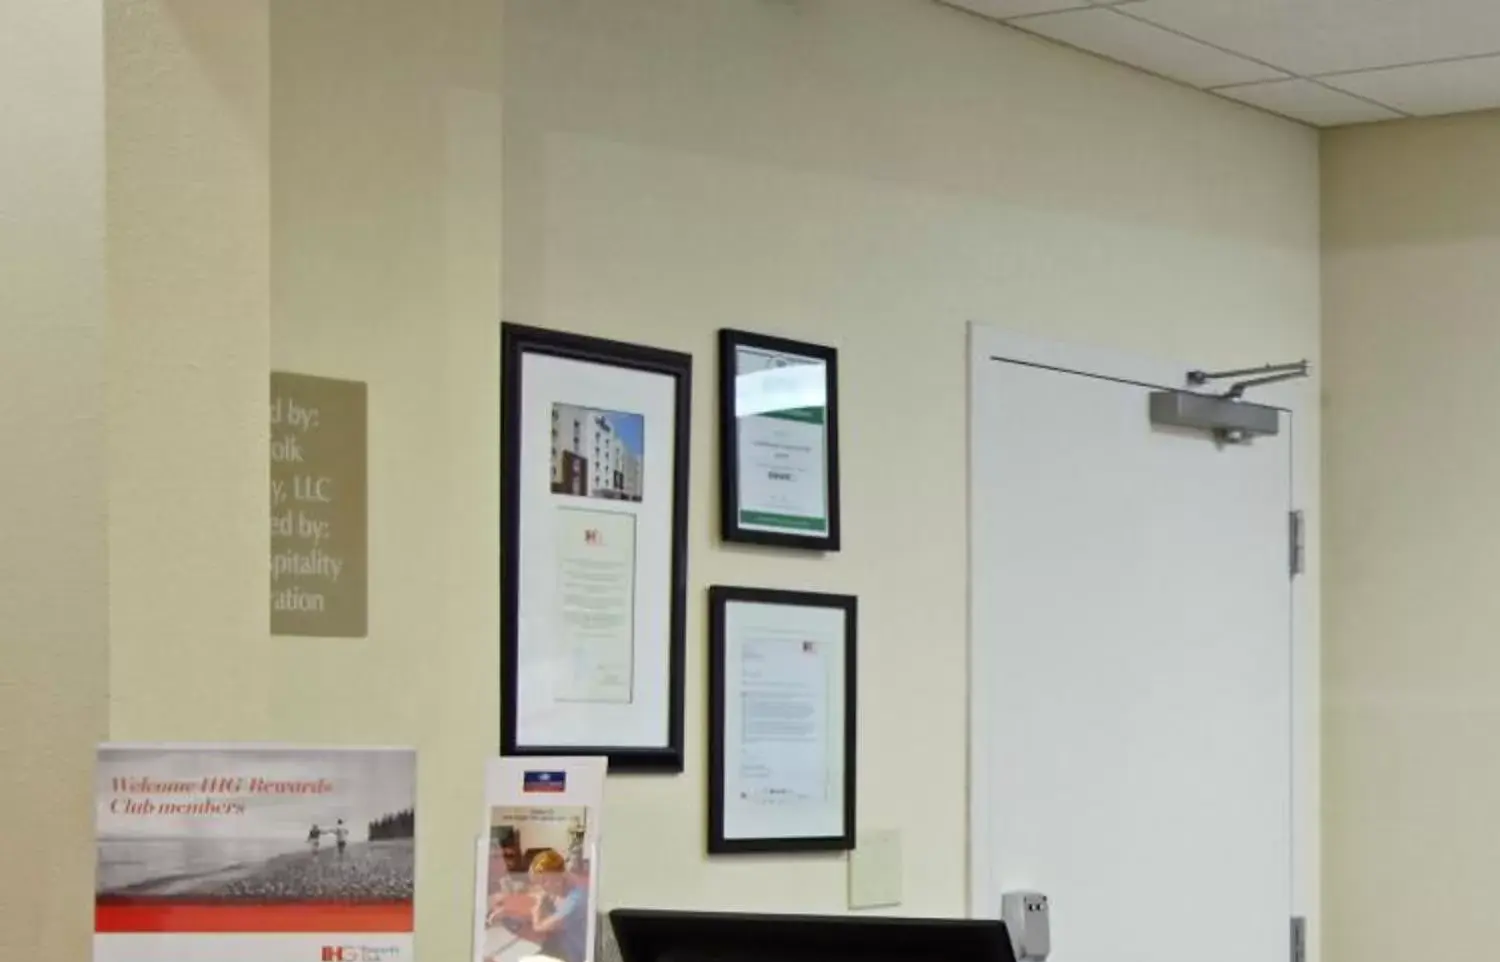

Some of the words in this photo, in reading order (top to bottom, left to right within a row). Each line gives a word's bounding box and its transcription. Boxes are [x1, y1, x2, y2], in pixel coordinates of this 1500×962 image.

[287, 397, 320, 433] by:
[293, 475, 333, 503] LLC
[299, 511, 329, 547] by:
[111, 776, 195, 794] Welcome
[200, 776, 244, 794] IHG
[247, 776, 333, 795] Rewards
[109, 798, 156, 815] Club
[157, 798, 245, 815] members
